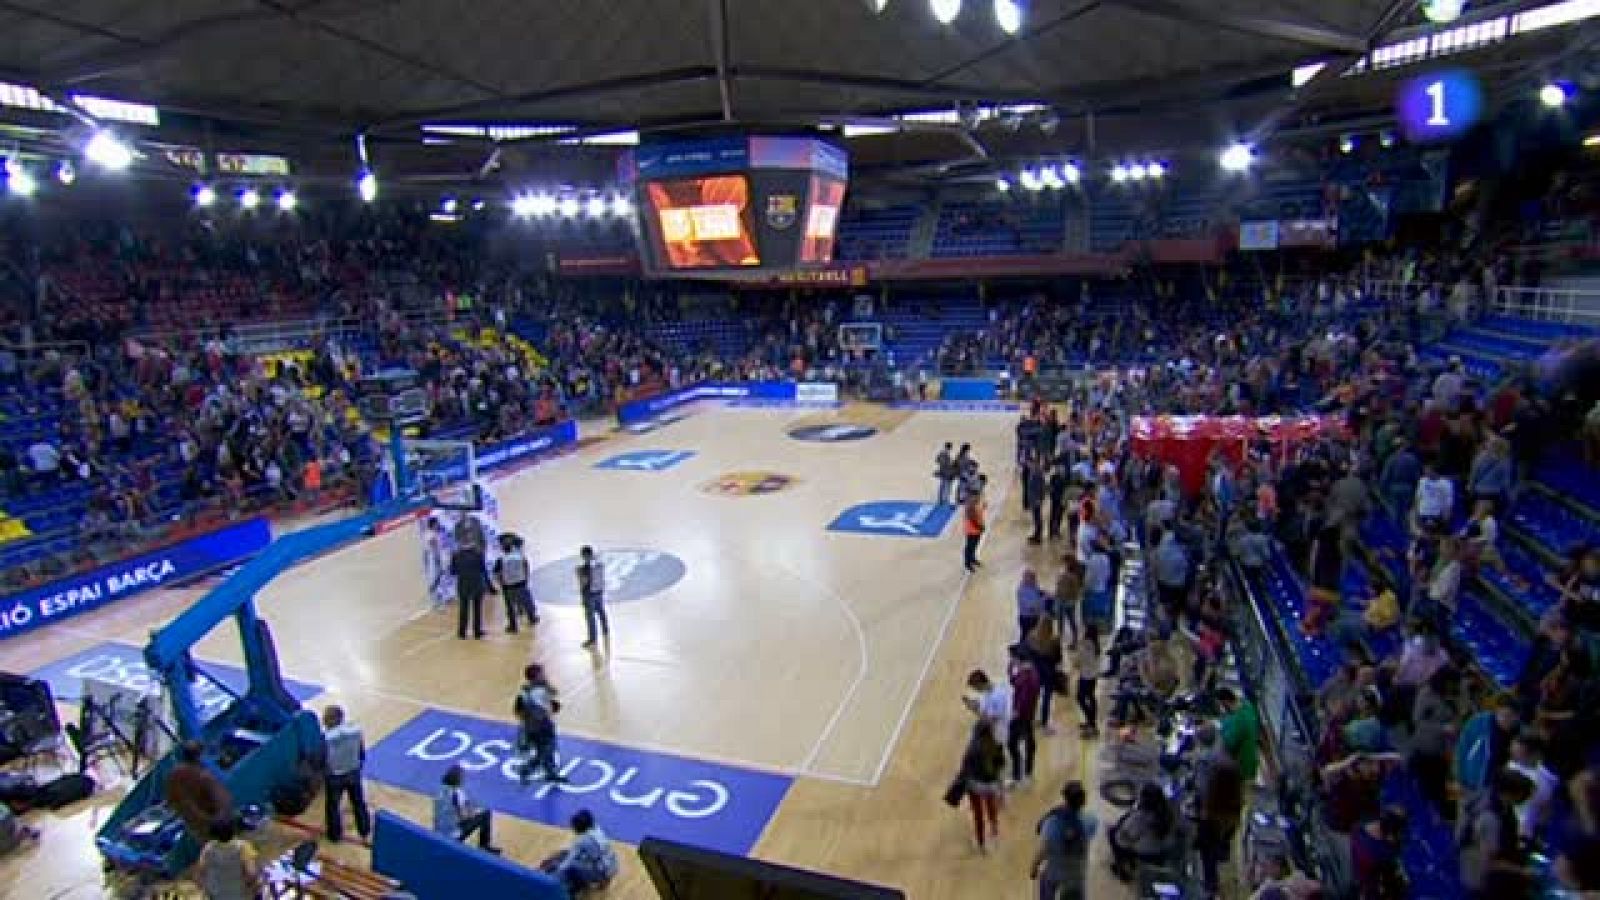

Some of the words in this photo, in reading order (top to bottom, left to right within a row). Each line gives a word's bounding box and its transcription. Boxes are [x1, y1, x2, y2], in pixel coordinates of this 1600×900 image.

[0, 601, 32, 631] IÓ
[39, 582, 102, 616] ESPAI
[107, 559, 175, 595] BARÇA
